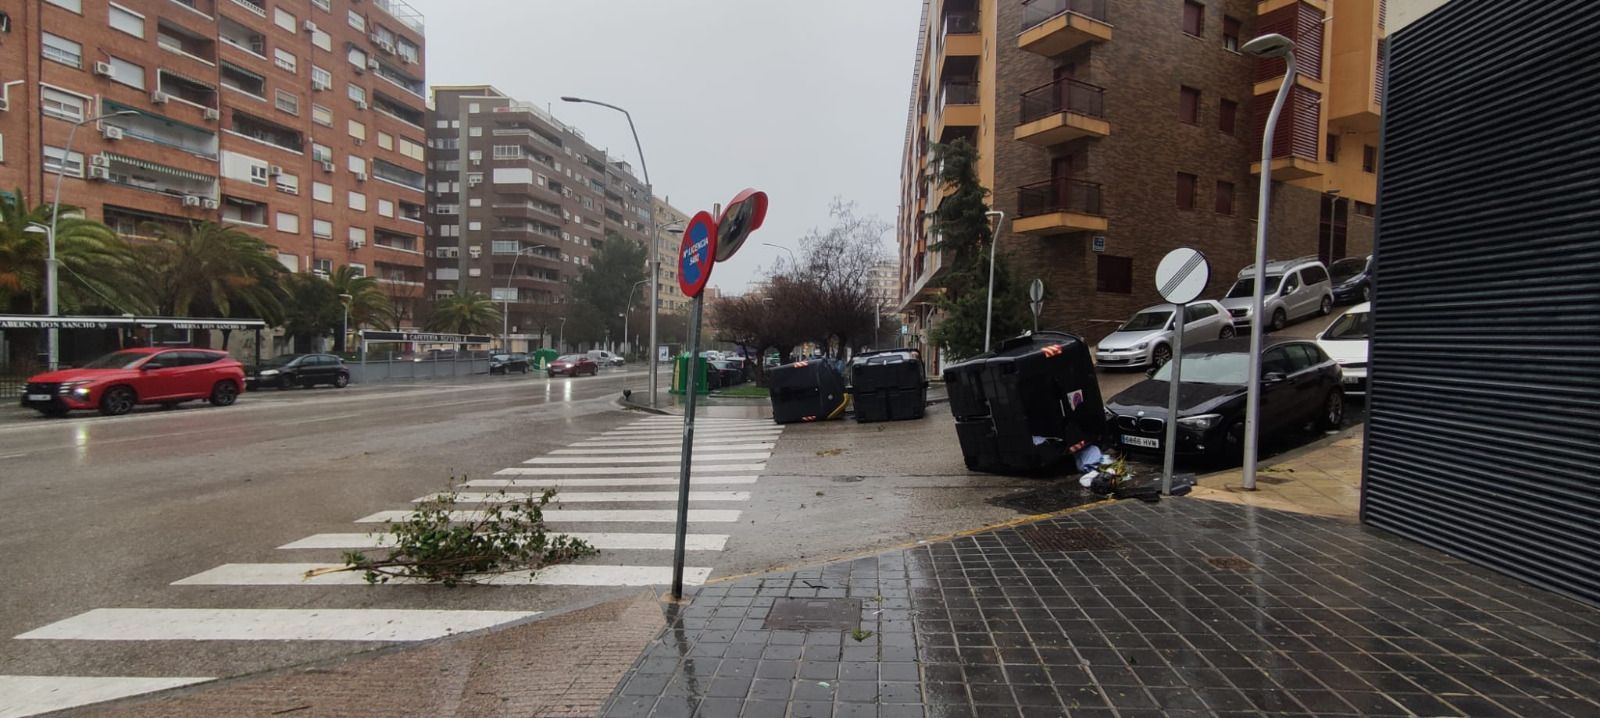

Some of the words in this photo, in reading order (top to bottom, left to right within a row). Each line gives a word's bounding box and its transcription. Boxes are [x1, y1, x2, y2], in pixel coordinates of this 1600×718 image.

[688, 237, 708, 255] LICENCIA
[62, 321, 96, 329] SANCHO
[410, 334, 438, 342] CAFETERIA
